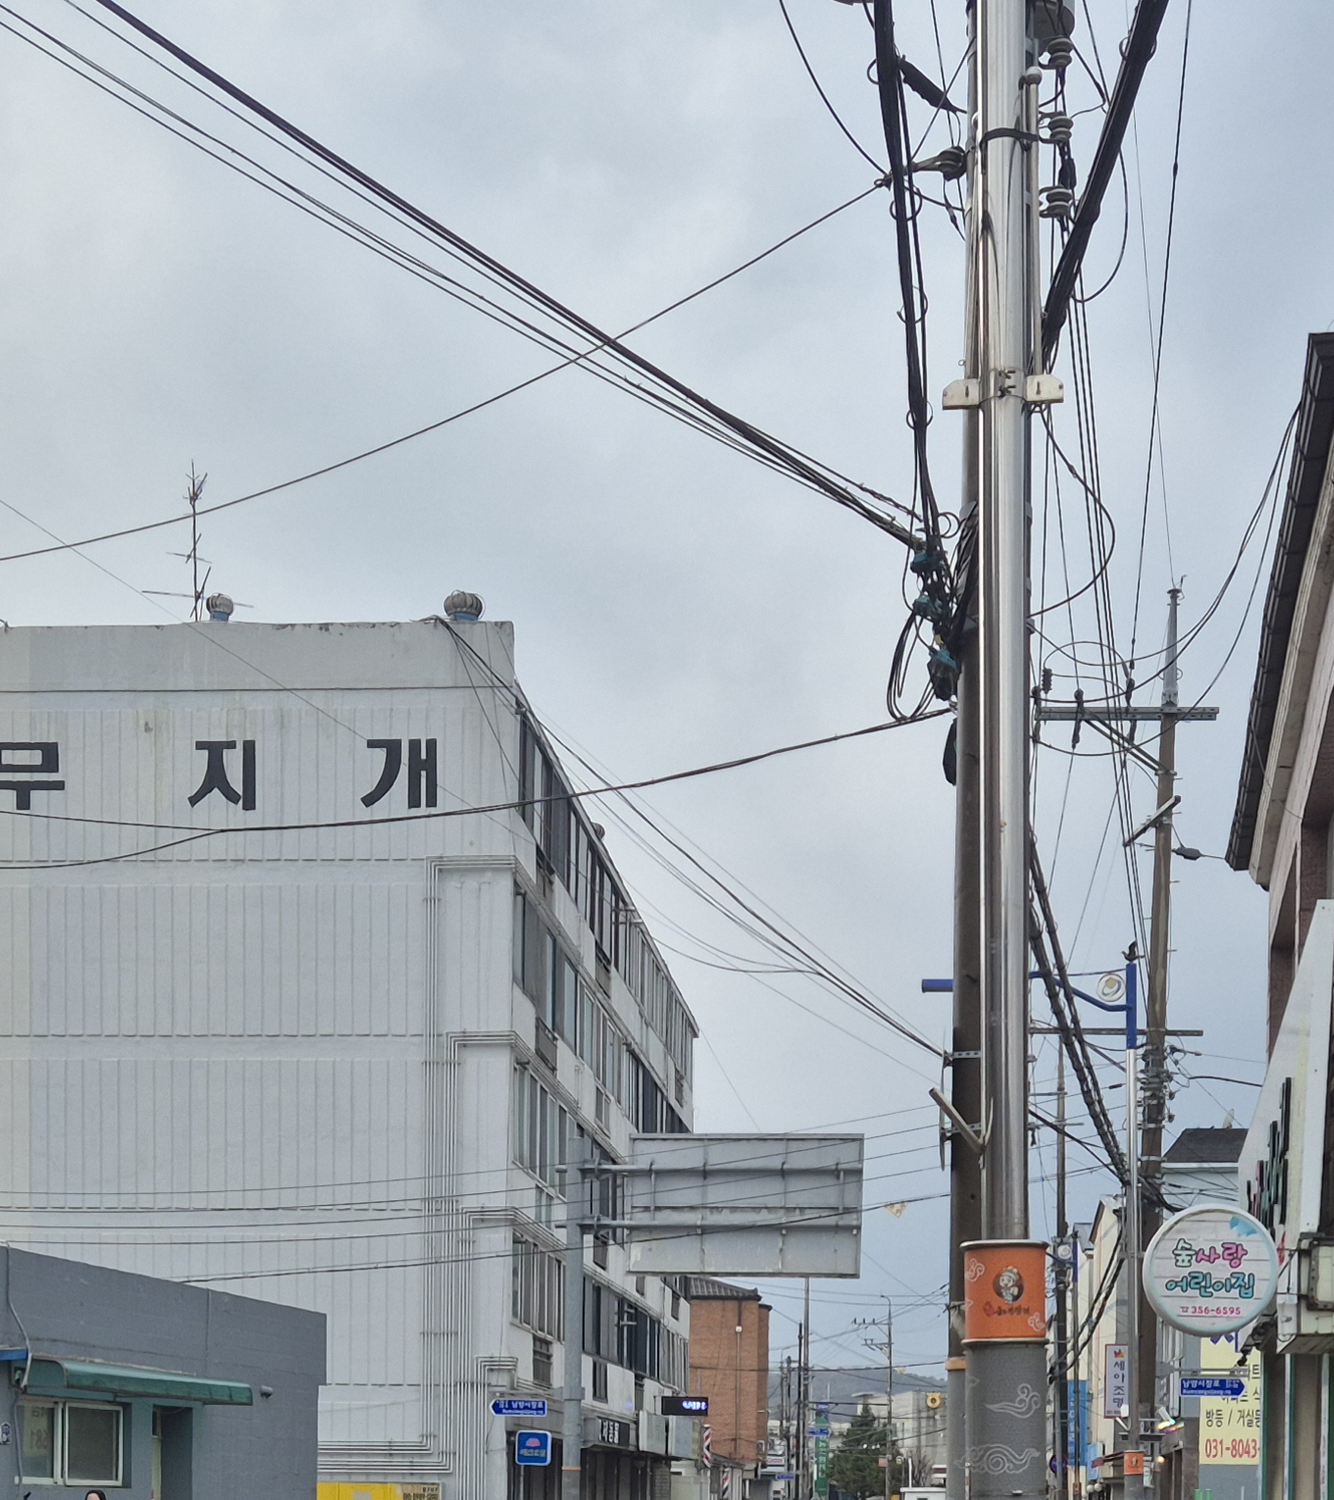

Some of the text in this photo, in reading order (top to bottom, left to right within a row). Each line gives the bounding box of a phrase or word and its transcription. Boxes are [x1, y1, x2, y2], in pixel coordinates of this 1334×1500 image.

[1172, 1238, 1248, 1268] 숲사랑
[1165, 1271, 1255, 1299] 어린이집
[1191, 1306, 1241, 1315] 356-6595
[1205, 1409, 1224, 1428] 방등
